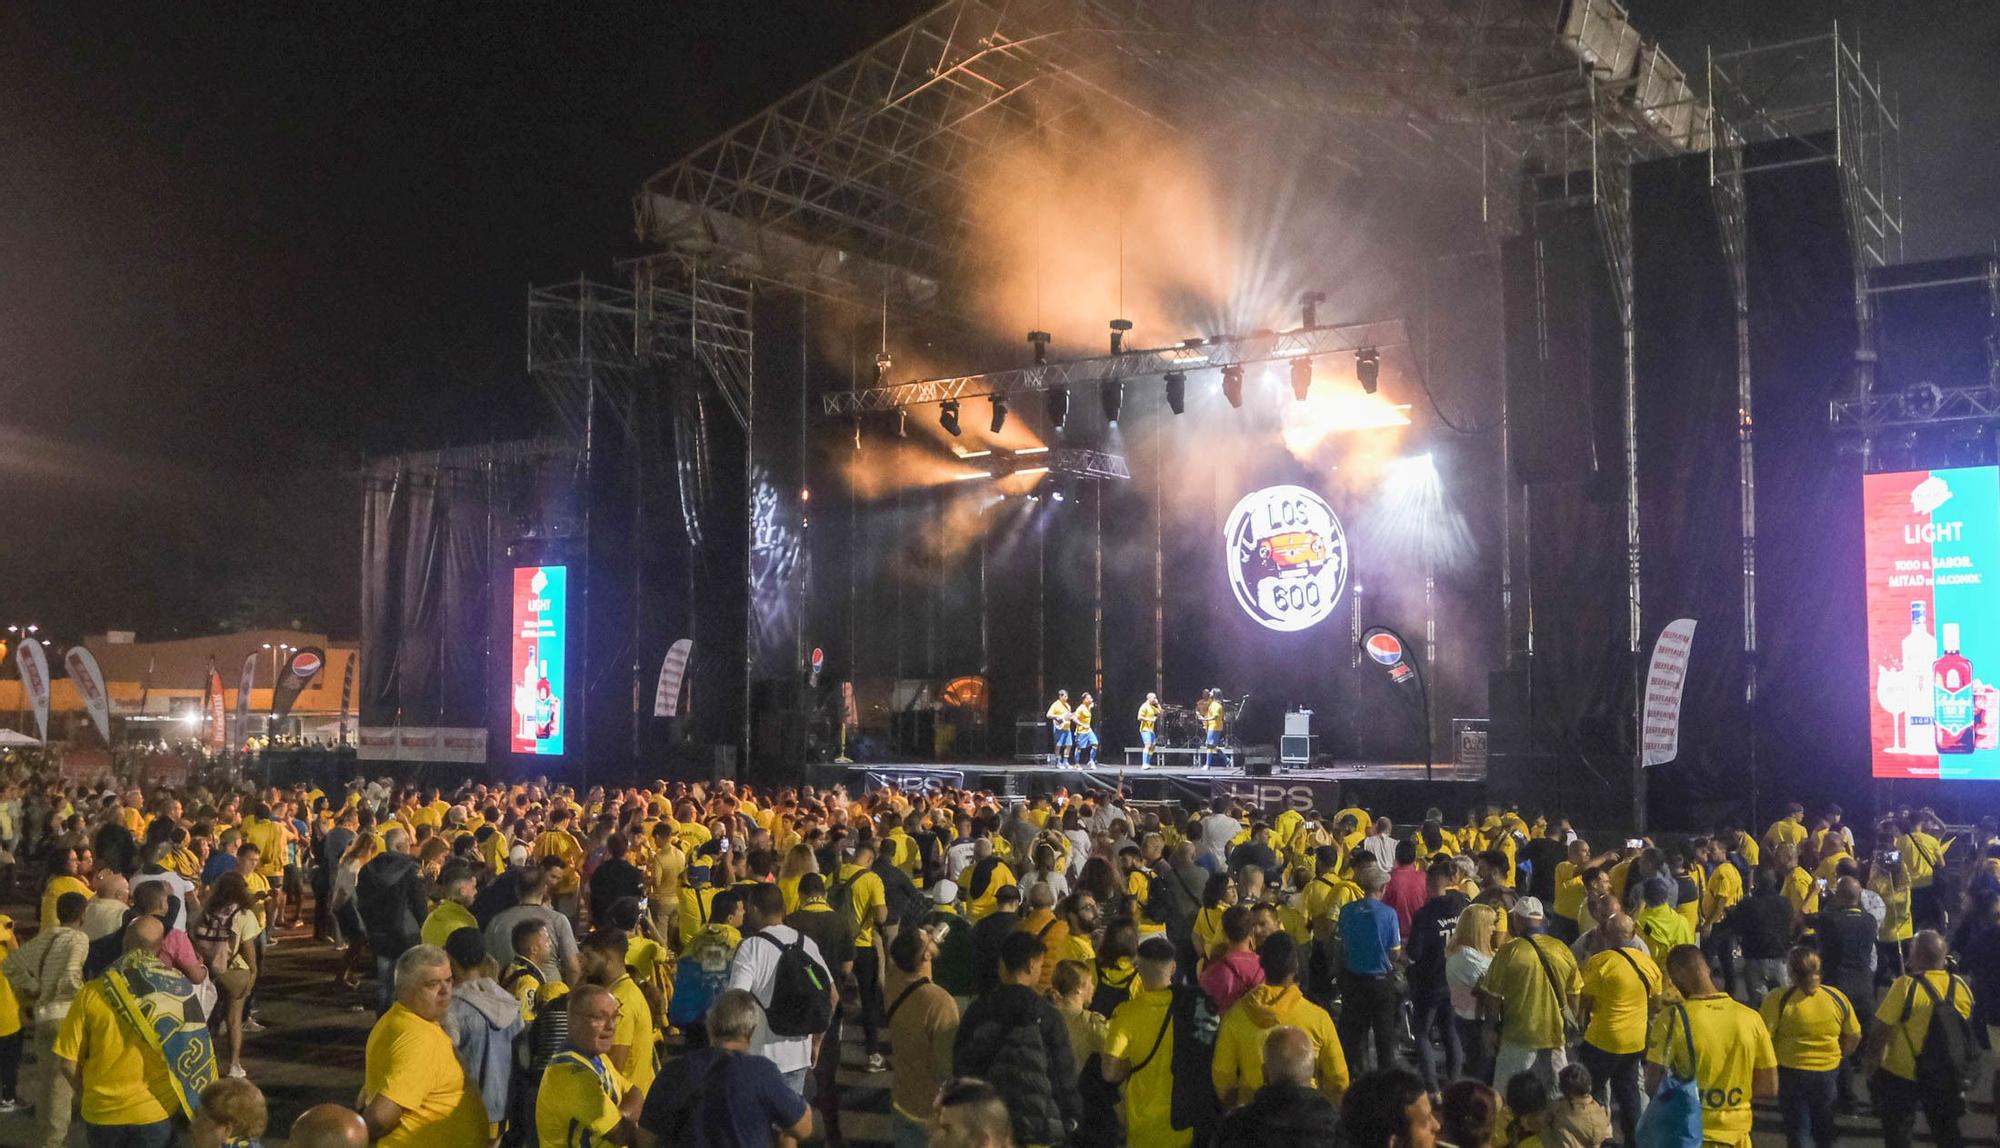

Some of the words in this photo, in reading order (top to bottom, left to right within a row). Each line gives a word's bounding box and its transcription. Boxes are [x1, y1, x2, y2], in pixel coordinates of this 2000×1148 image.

[1268, 500, 1307, 529] LOS
[1904, 521, 1963, 544] LIGHT
[1888, 574, 1924, 587] MITAD
[1273, 581, 1320, 611] 600
